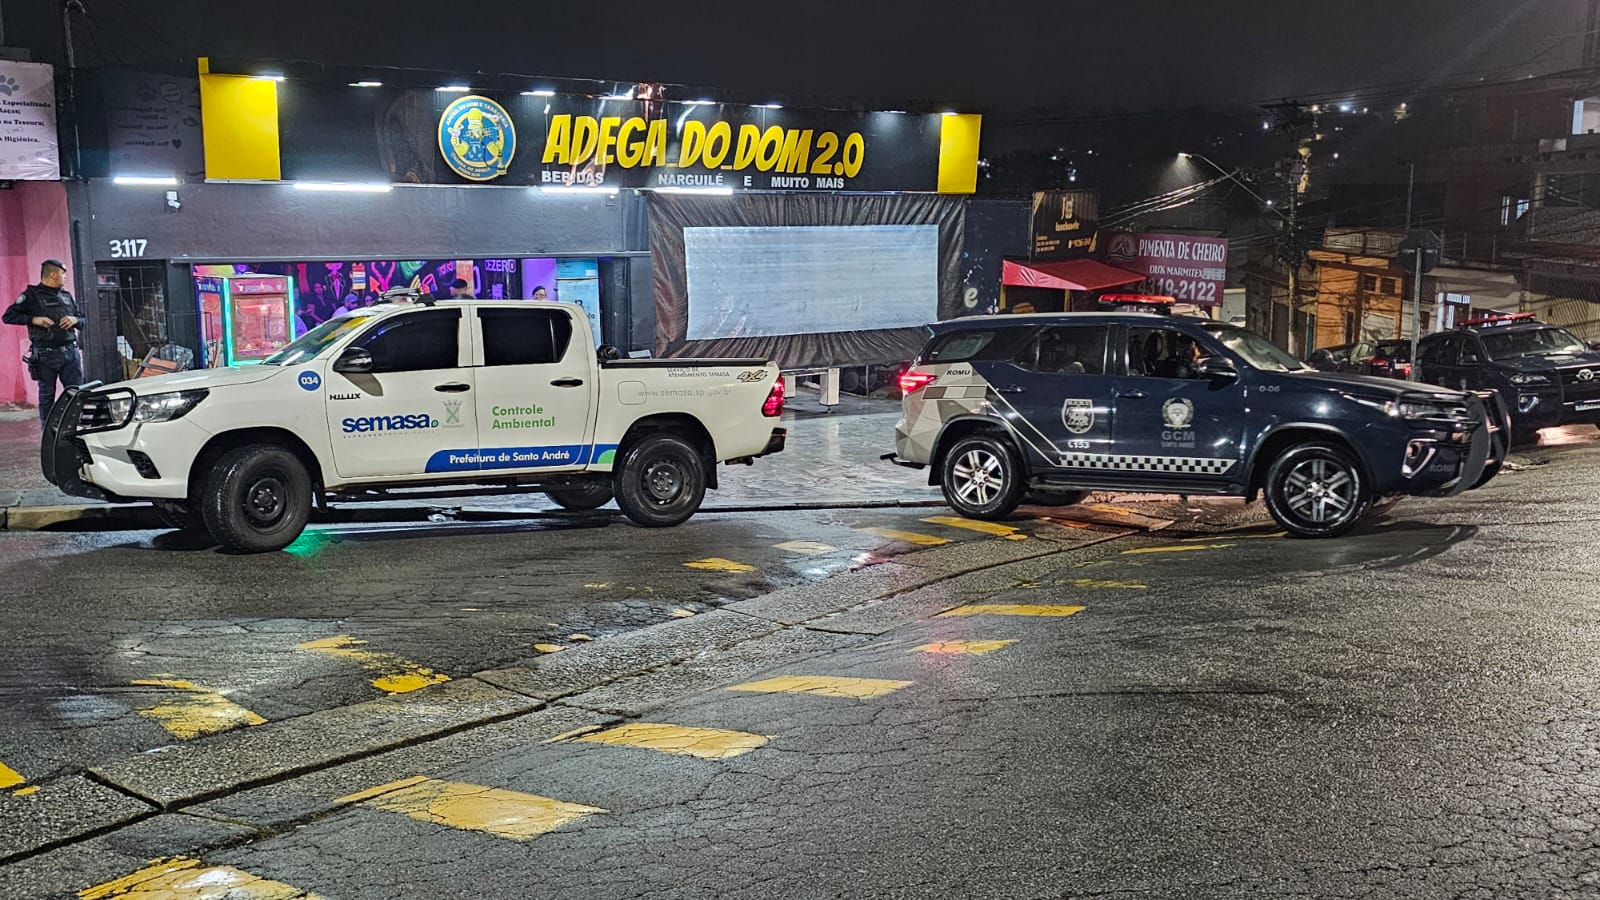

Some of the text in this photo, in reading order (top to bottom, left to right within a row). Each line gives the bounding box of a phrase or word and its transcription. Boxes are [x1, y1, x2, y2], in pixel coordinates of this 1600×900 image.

[541, 170, 604, 184] BEBIDAS
[658, 173, 844, 189] NARGUILÉ E MUITO MAIS
[1138, 238, 1225, 262] PIMENTA DE CHEIRO
[301, 377, 319, 385] 034
[492, 404, 544, 416] Controle
[342, 413, 430, 433] semasa
[492, 417, 555, 430] Ambiental
[1161, 430, 1195, 441] GCM
[450, 450, 570, 464] Prefeitura de Santo André
